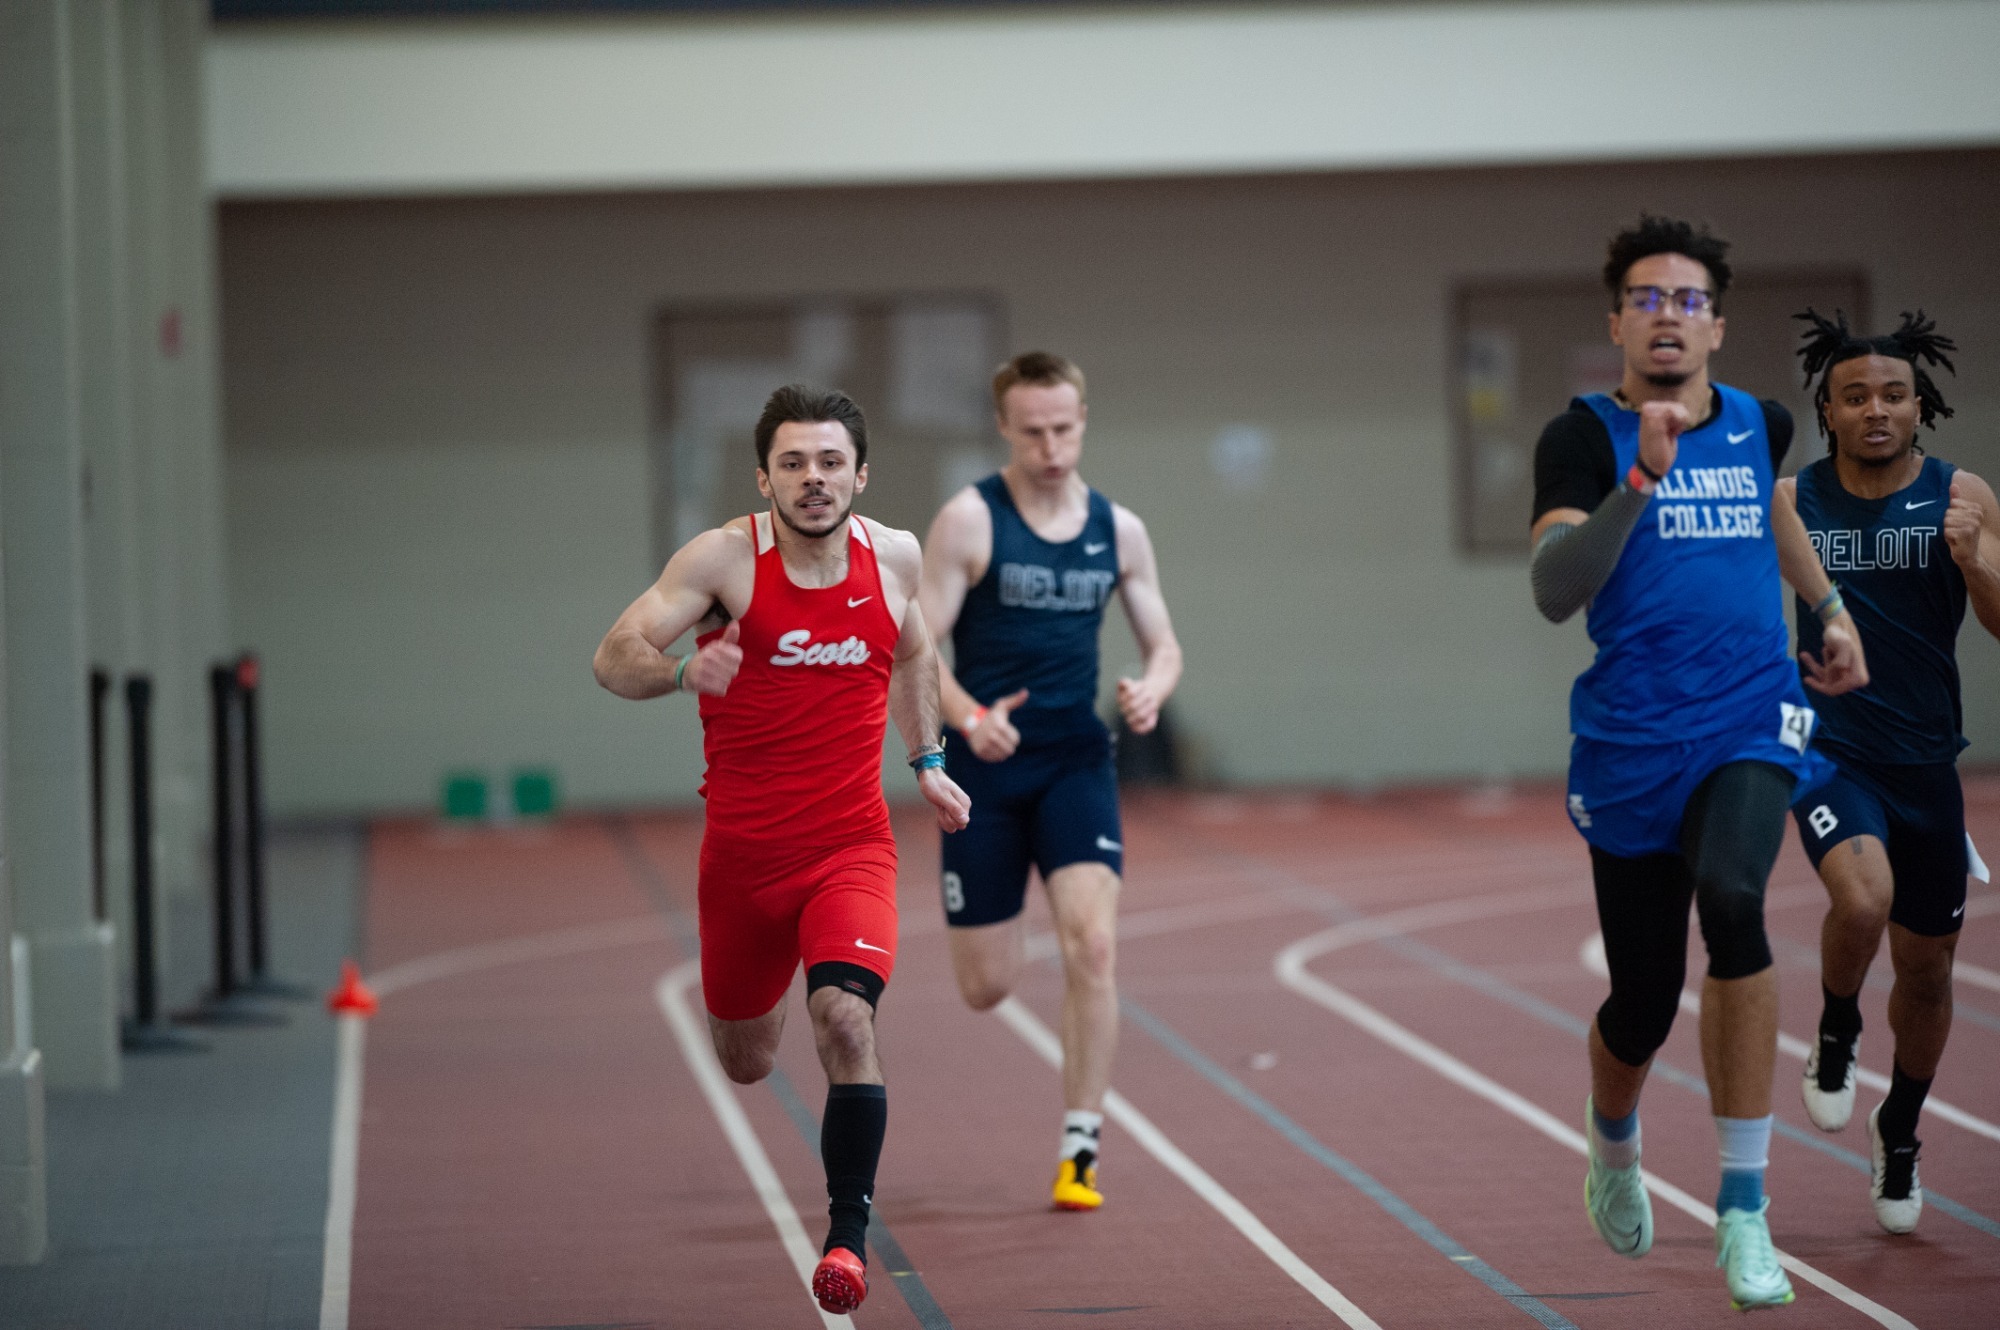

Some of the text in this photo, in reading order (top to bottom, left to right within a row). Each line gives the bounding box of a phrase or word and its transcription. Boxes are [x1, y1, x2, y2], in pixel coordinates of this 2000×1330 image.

[1658, 504, 1763, 539] COLLEGE
[1808, 526, 1938, 571] BELOIT
[769, 629, 871, 666] Scots
[1807, 804, 1839, 839] B
